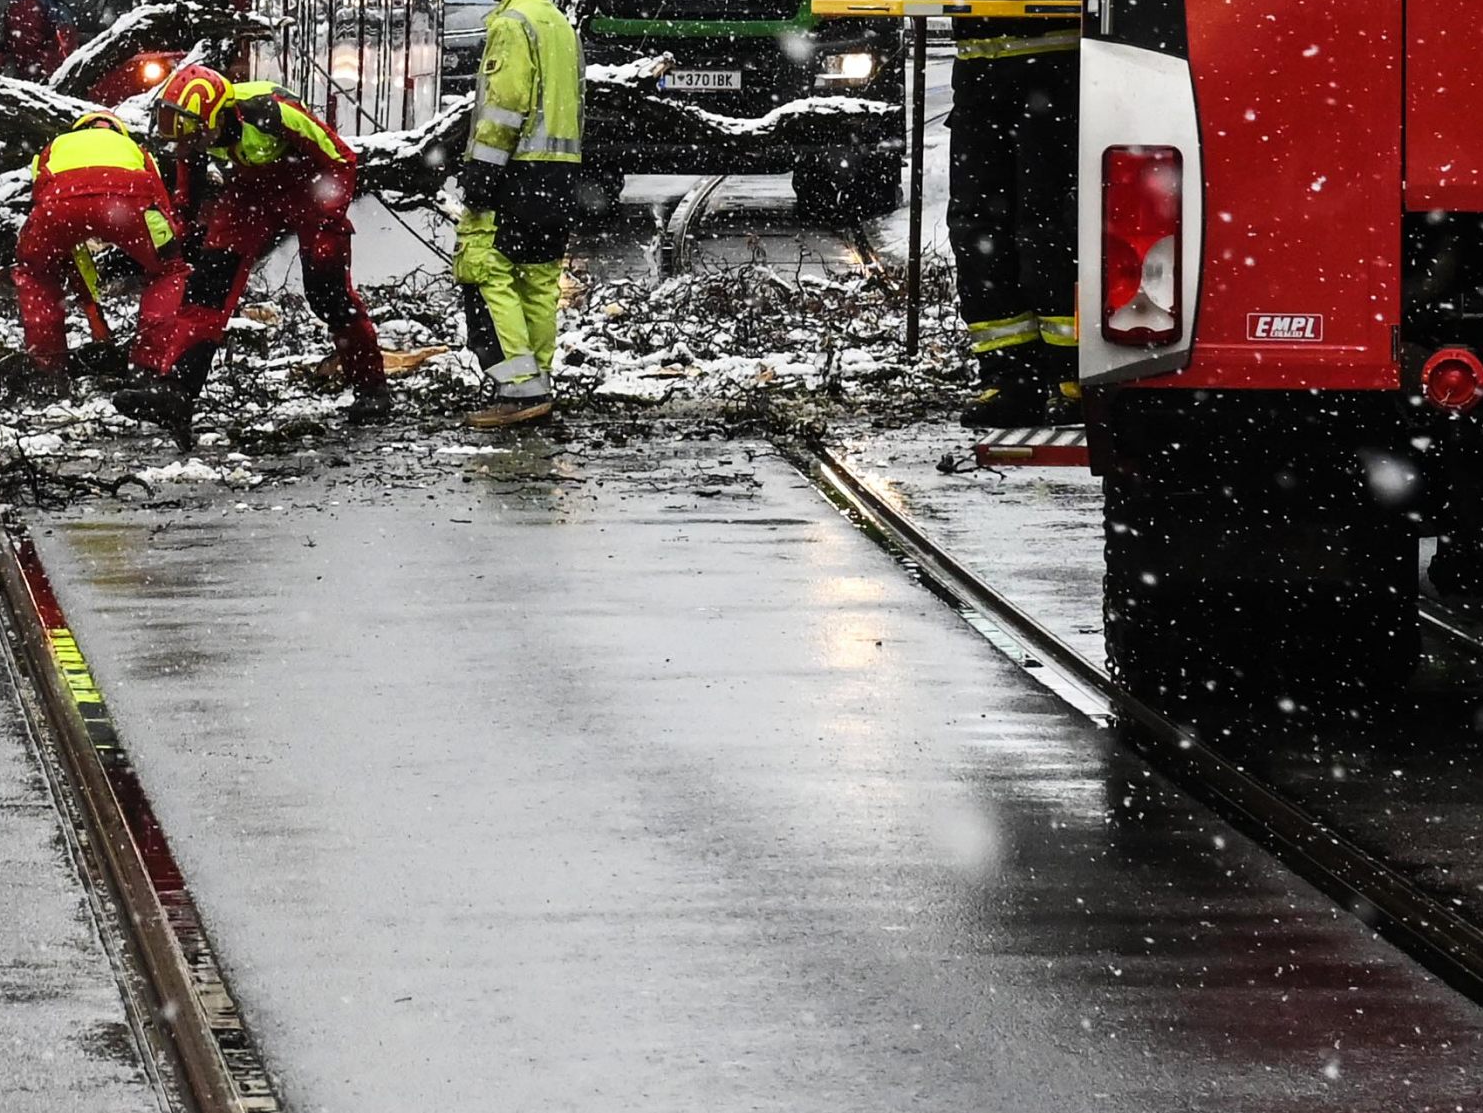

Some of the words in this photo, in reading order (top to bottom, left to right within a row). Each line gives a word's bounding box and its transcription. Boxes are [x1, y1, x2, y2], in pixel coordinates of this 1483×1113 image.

[686, 73, 710, 86] 370
[713, 74, 733, 87] IBK
[1256, 316, 1315, 338] EMPL
